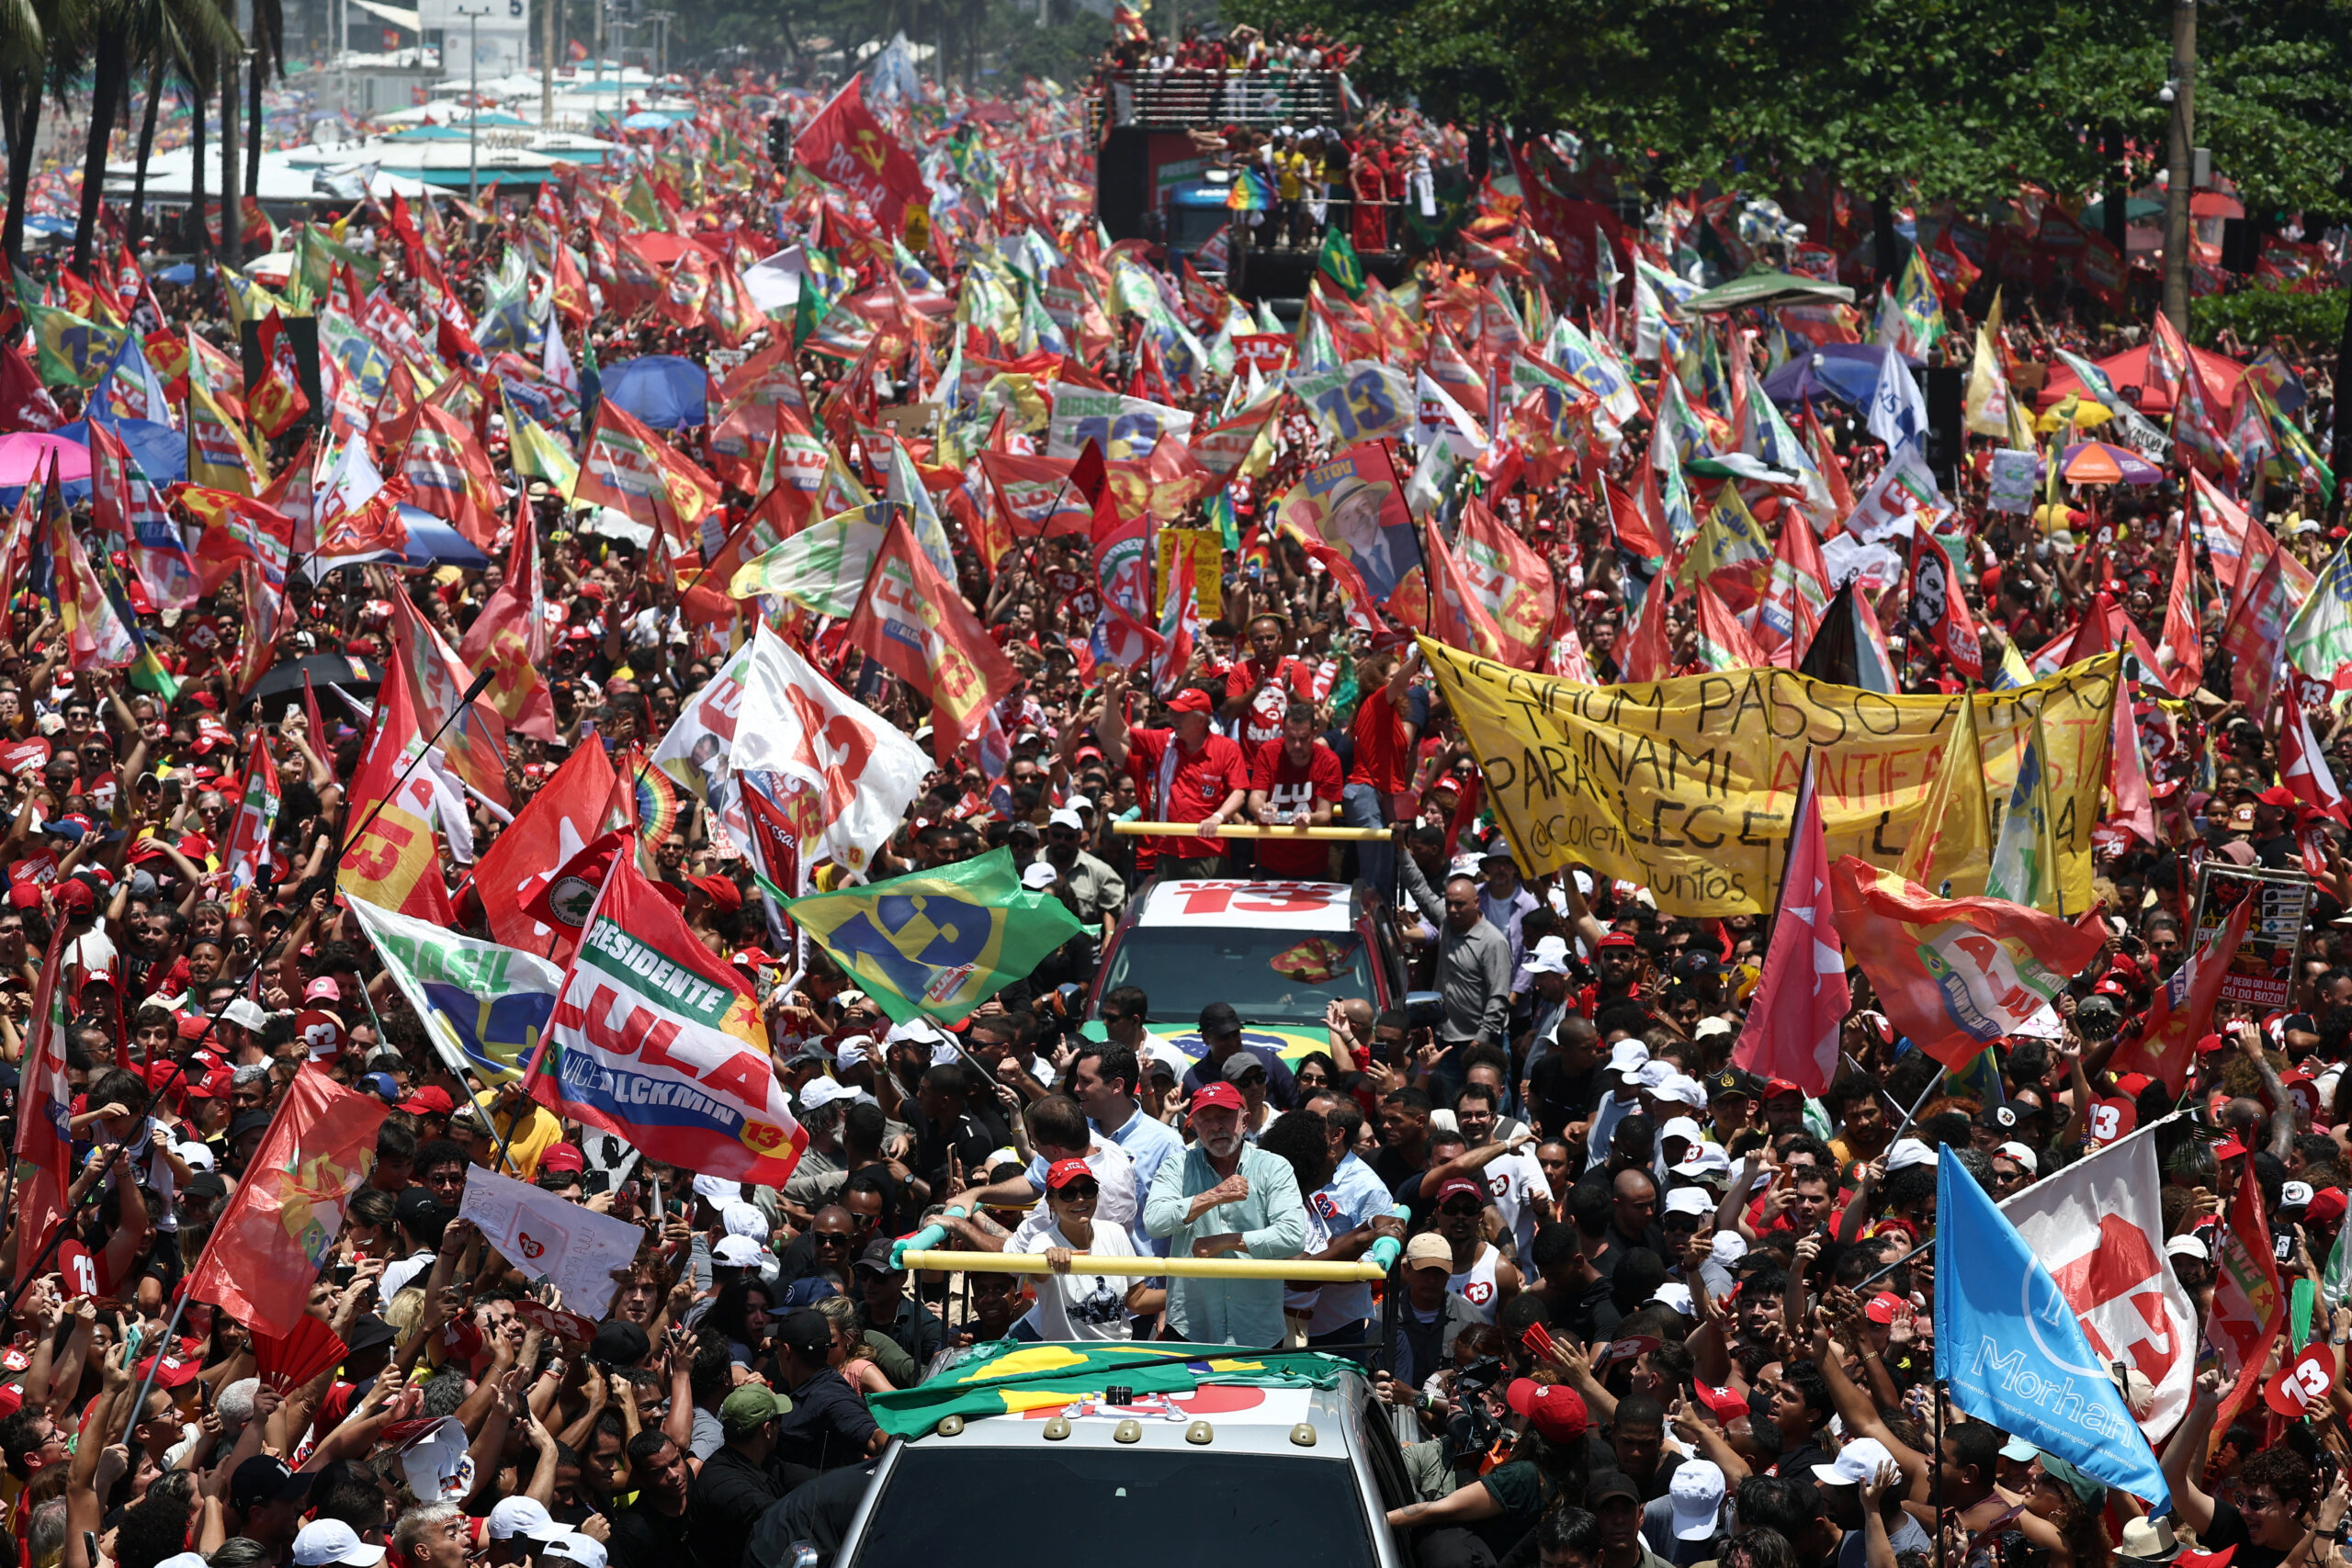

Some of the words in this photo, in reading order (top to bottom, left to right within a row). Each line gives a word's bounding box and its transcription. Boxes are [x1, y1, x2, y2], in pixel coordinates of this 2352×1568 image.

[1317, 370, 1395, 440] 13
[1054, 571, 1077, 590] 13
[1072, 592, 1094, 616] 13
[1698, 668, 1900, 746] PASSO
[2301, 680, 2327, 705] 13
[1485, 745, 1600, 810] PARA
[1272, 781, 1313, 804] LU
[847, 846, 863, 864] 13
[1174, 887, 1332, 916] 13
[929, 967, 963, 1000] LULA
[2233, 976, 2253, 988] DEDO
[2253, 978, 2264, 989] DO
[2264, 980, 2287, 992] LULA?
[2237, 988, 2253, 1000] DO
[2254, 990, 2285, 1004] BOZO!
[305, 1021, 337, 1063] 13
[562, 1047, 601, 1089] VICE
[598, 1071, 737, 1127] ALCKMIN
[746, 1121, 785, 1150] 13
[2089, 1103, 2120, 1141] 13
[1489, 1177, 1507, 1196] 13
[522, 1237, 539, 1258] 13
[74, 1254, 97, 1296] 13
[1468, 1283, 1489, 1303] 13
[1970, 1334, 2132, 1449] Morhan
[2280, 1358, 2330, 1408] 13
[2025, 1411, 2037, 1424] das
[2060, 1428, 2090, 1450] atingidas
